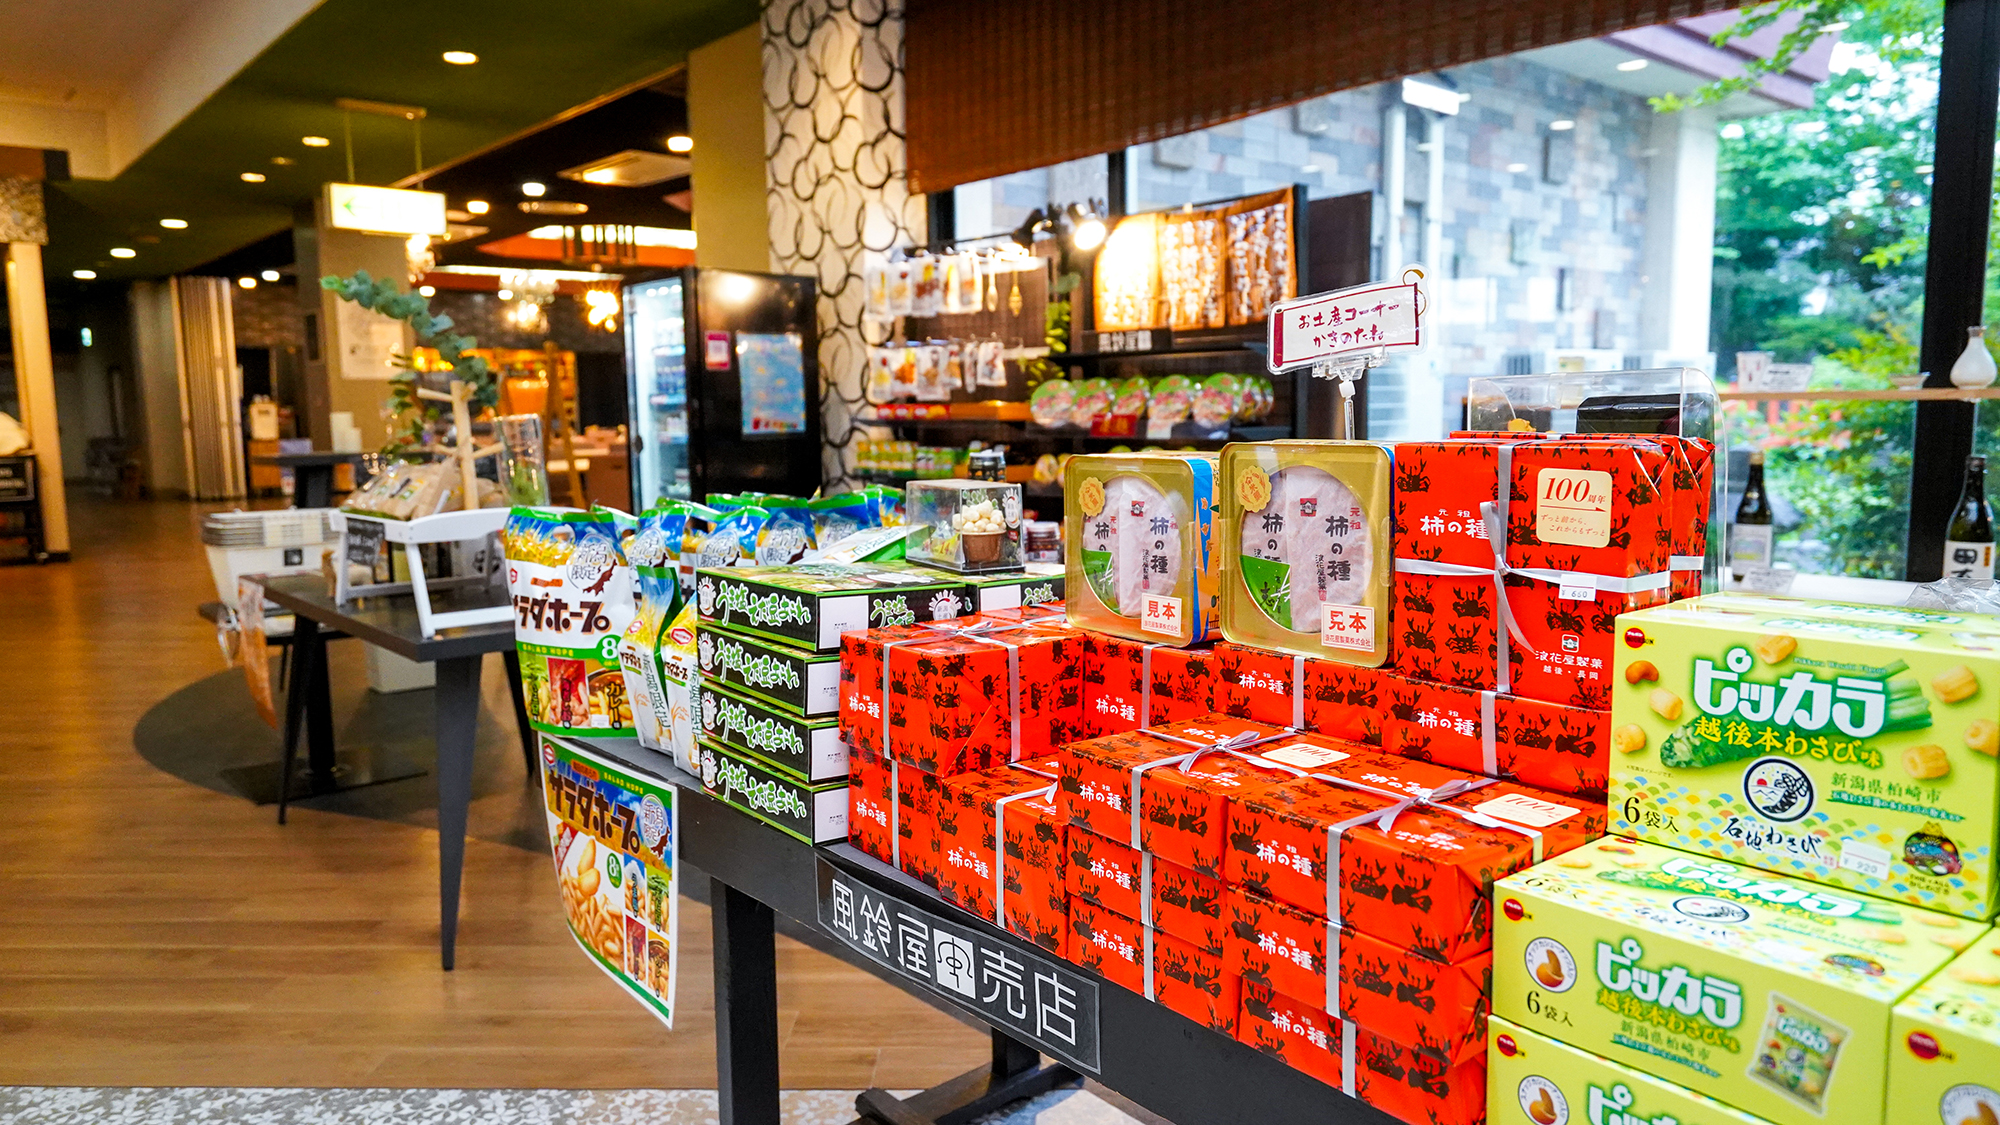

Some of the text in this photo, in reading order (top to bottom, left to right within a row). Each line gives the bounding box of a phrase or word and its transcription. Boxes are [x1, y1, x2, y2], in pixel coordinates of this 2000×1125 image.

[1298, 301, 1399, 330] お土産コーナー
[1541, 477, 1607, 504] 100周年
[1350, 507, 1362, 530] 元祖
[1420, 515, 1489, 540] 柿の種
[1438, 508, 1471, 518] 元祖
[1149, 516, 1170, 574] 柿の種
[1261, 512, 1284, 563] 柿の
[1325, 515, 1351, 582] 柿の種
[571, 565, 596, 581] 限定
[1147, 600, 1176, 621] 見本
[1328, 610, 1367, 634] 見本
[601, 637, 618, 659] 8
[1535, 650, 1604, 670] 浪花屋製菓
[1238, 673, 1285, 696] 柿の種
[1694, 647, 1887, 739] ピッカラ
[1096, 698, 1136, 722] 柿の種
[1417, 711, 1475, 737] 柿の種
[1693, 715, 1881, 767] 越後本わさび味
[1079, 783, 1123, 812] 柿の種
[1830, 771, 1943, 804] 新潟県柏崎市
[549, 769, 641, 855] サラダホープ
[1624, 796, 1680, 834] 6袋入
[947, 849, 990, 880] 柿の種
[1089, 860, 1132, 890] 柿の種
[1256, 842, 1313, 878] 柿の種
[1856, 860, 1879, 874] 920
[1661, 857, 1863, 918] ピッカラ
[1092, 930, 1135, 963] 柿の種
[1258, 932, 1313, 972] 柿の種
[980, 947, 1077, 1046] 売店
[1596, 938, 1742, 1029] ピッカラ
[1526, 990, 1574, 1028] 6袋入
[1271, 1010, 1328, 1051] 柿の種
